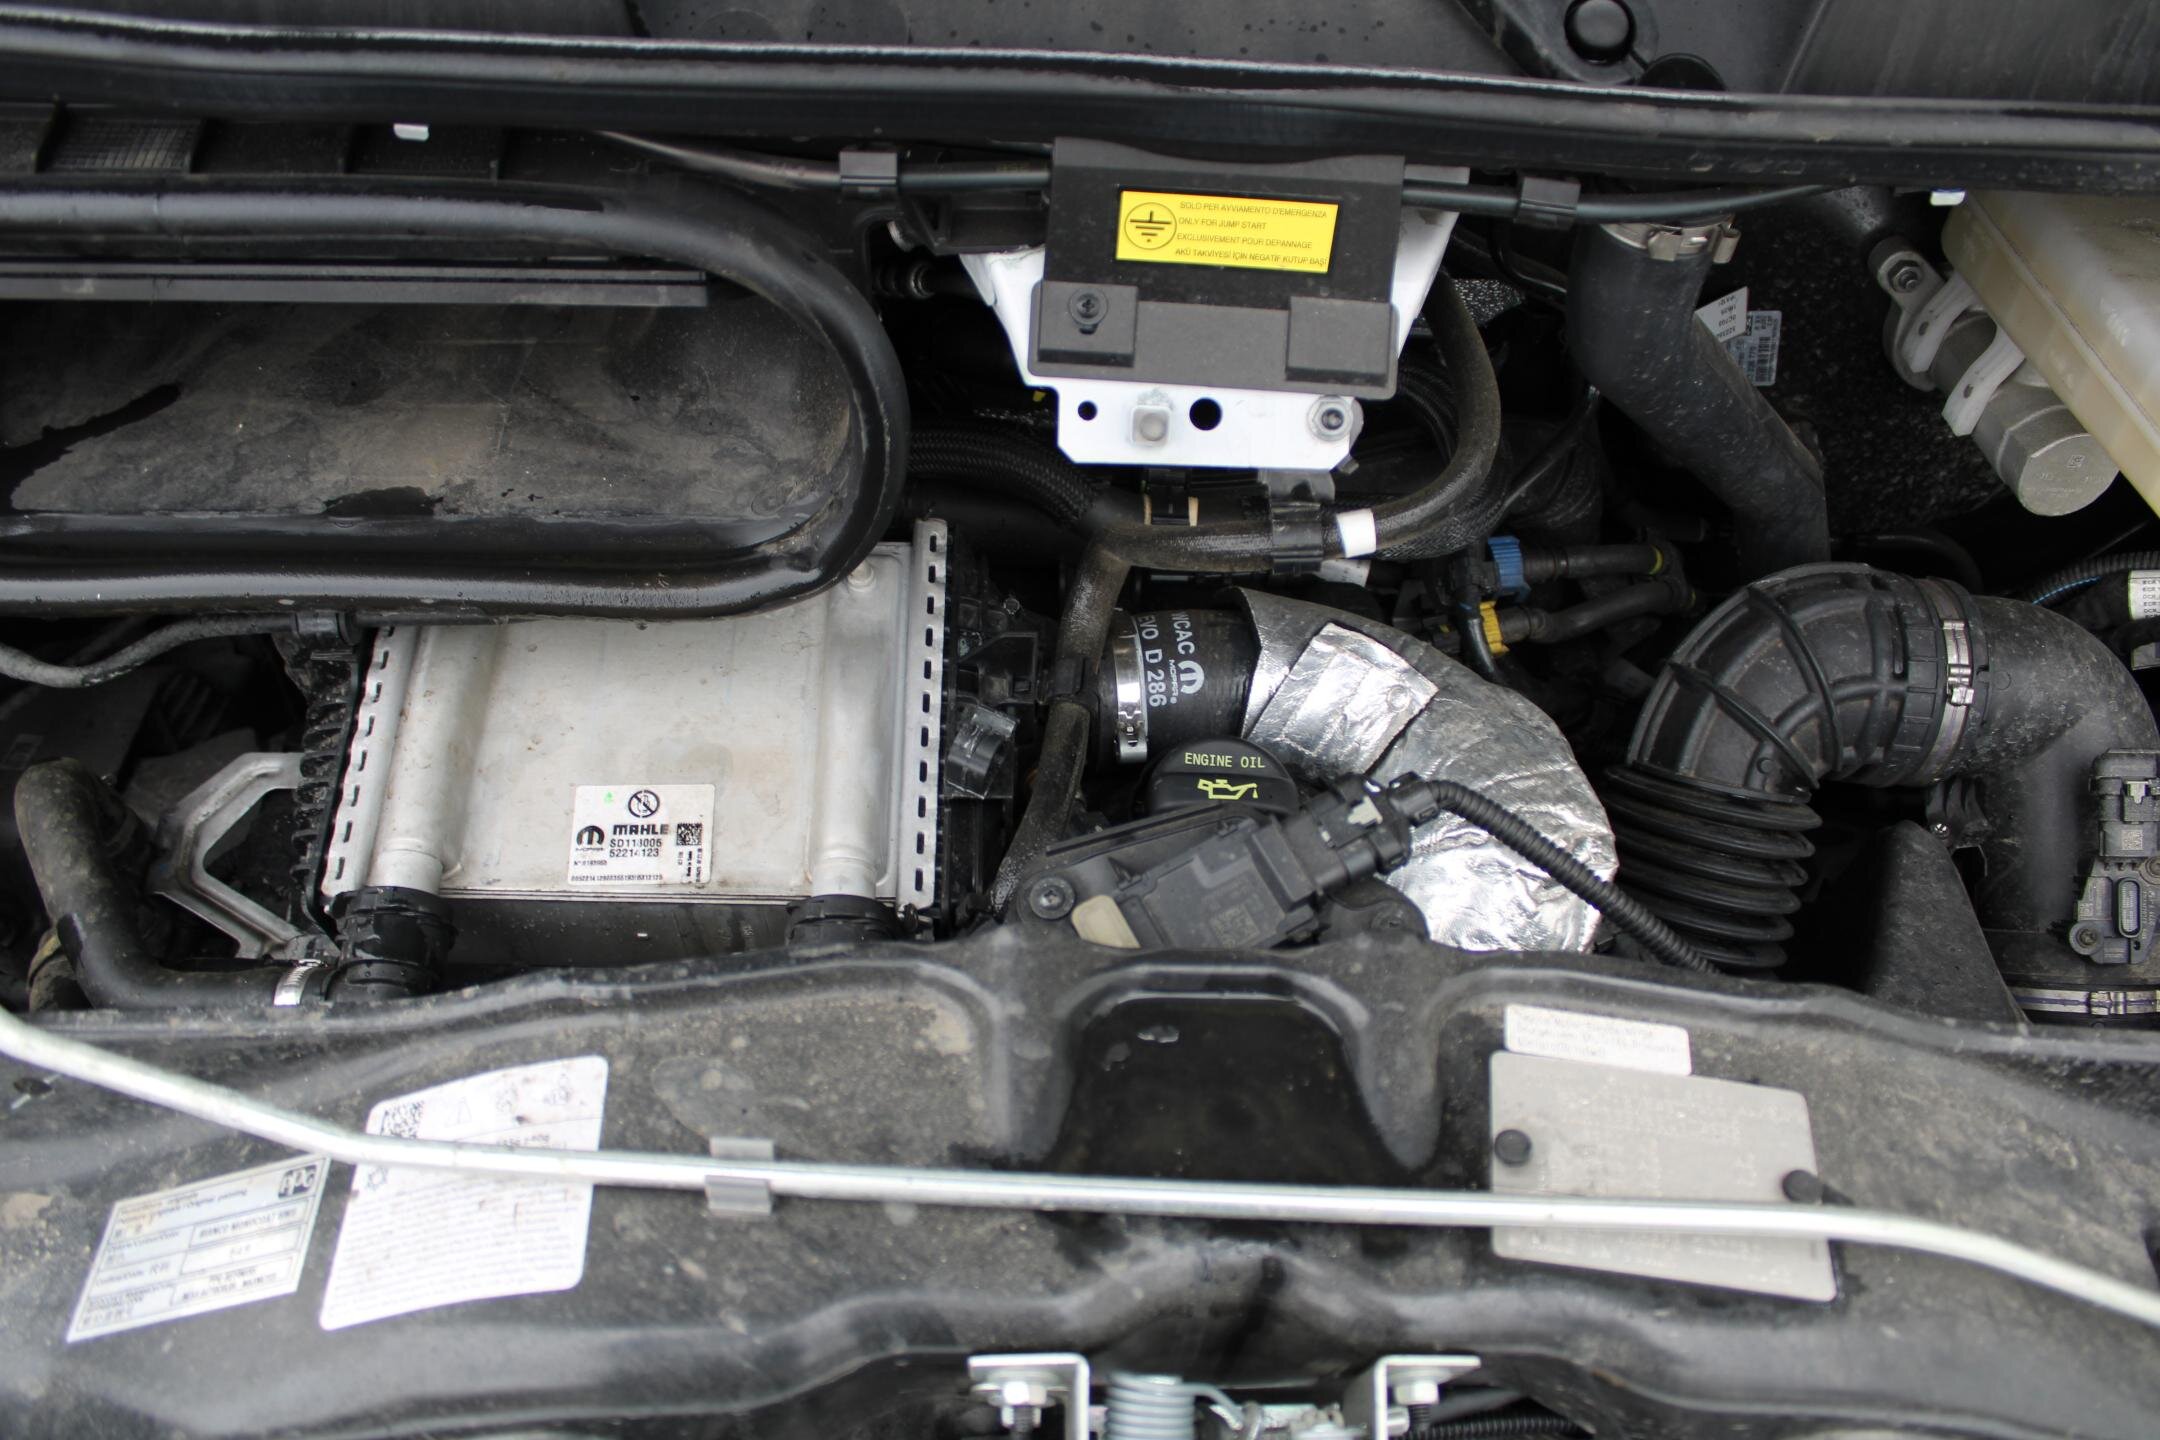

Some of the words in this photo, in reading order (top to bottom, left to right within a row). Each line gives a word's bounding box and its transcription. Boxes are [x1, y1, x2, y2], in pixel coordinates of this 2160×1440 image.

[1180, 201, 1203, 210] SOLO
[1203, 203, 1220, 211] PER
[1178, 217, 1199, 225] ONLY
[1201, 218, 1217, 226] FOR
[1218, 220, 1240, 228] JUMP
[1241, 221, 1267, 230] START
[1177, 232, 1240, 243] EXCLUSIVEMENT
[1242, 237, 1265, 246] POUR
[1138, 614, 1159, 640] EVO
[1145, 648, 1163, 664] D
[1169, 659, 1179, 697] MOPAR
[1147, 669, 1167, 707] 286
[1184, 752, 1233, 768] ENGINE
[1240, 756, 1266, 769] OIL
[613, 824, 670, 836] MAHLE
